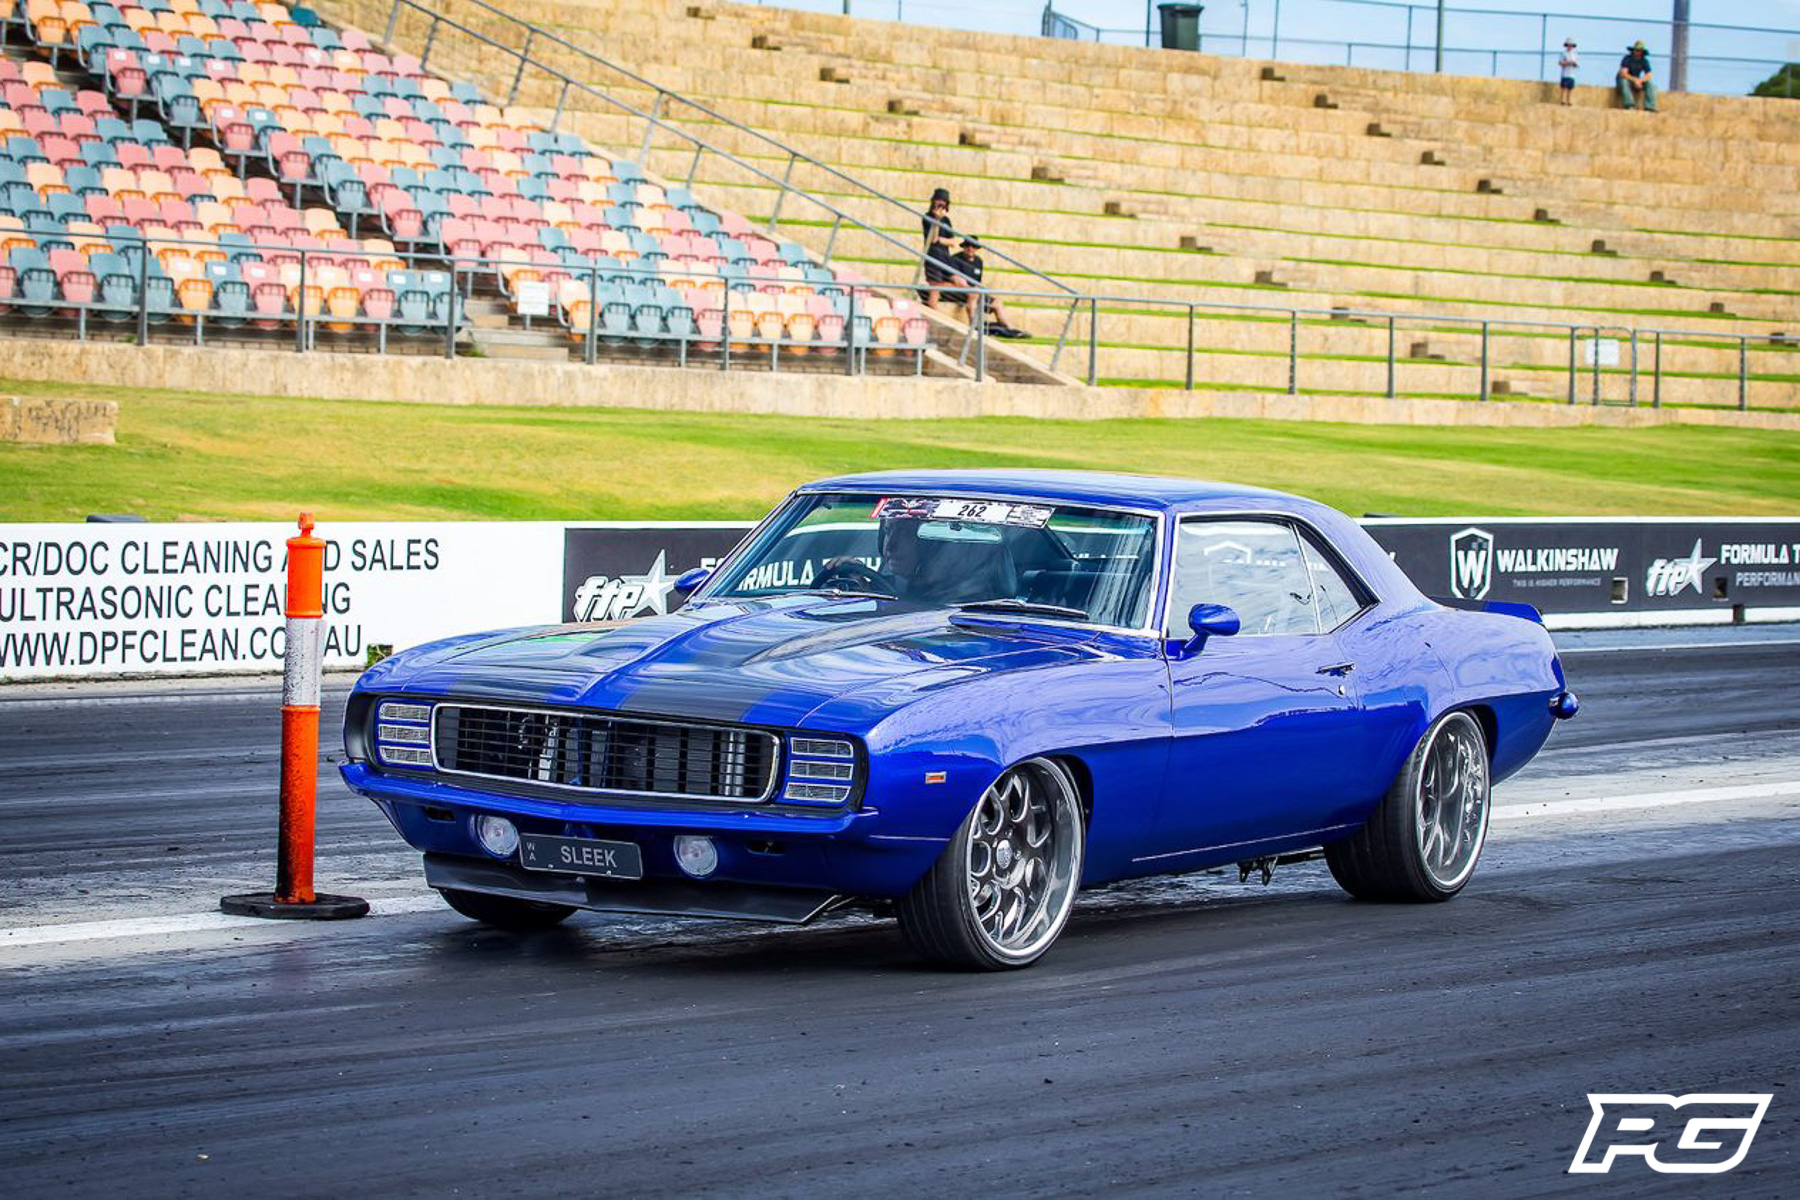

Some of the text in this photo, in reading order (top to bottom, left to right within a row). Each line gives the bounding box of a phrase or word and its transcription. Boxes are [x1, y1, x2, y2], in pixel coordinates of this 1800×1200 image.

[957, 504, 987, 518] 262
[121, 540, 272, 575] CLEANING
[351, 538, 440, 571] SALES
[1497, 548, 1619, 572] WALKINSHAW
[1721, 544, 1789, 564] FORMULA
[0, 582, 351, 622] ULTRASONIC CLEAG
[0, 624, 361, 667] WW.DPFCLEAN.COAU
[560, 845, 618, 868] SLEEK
